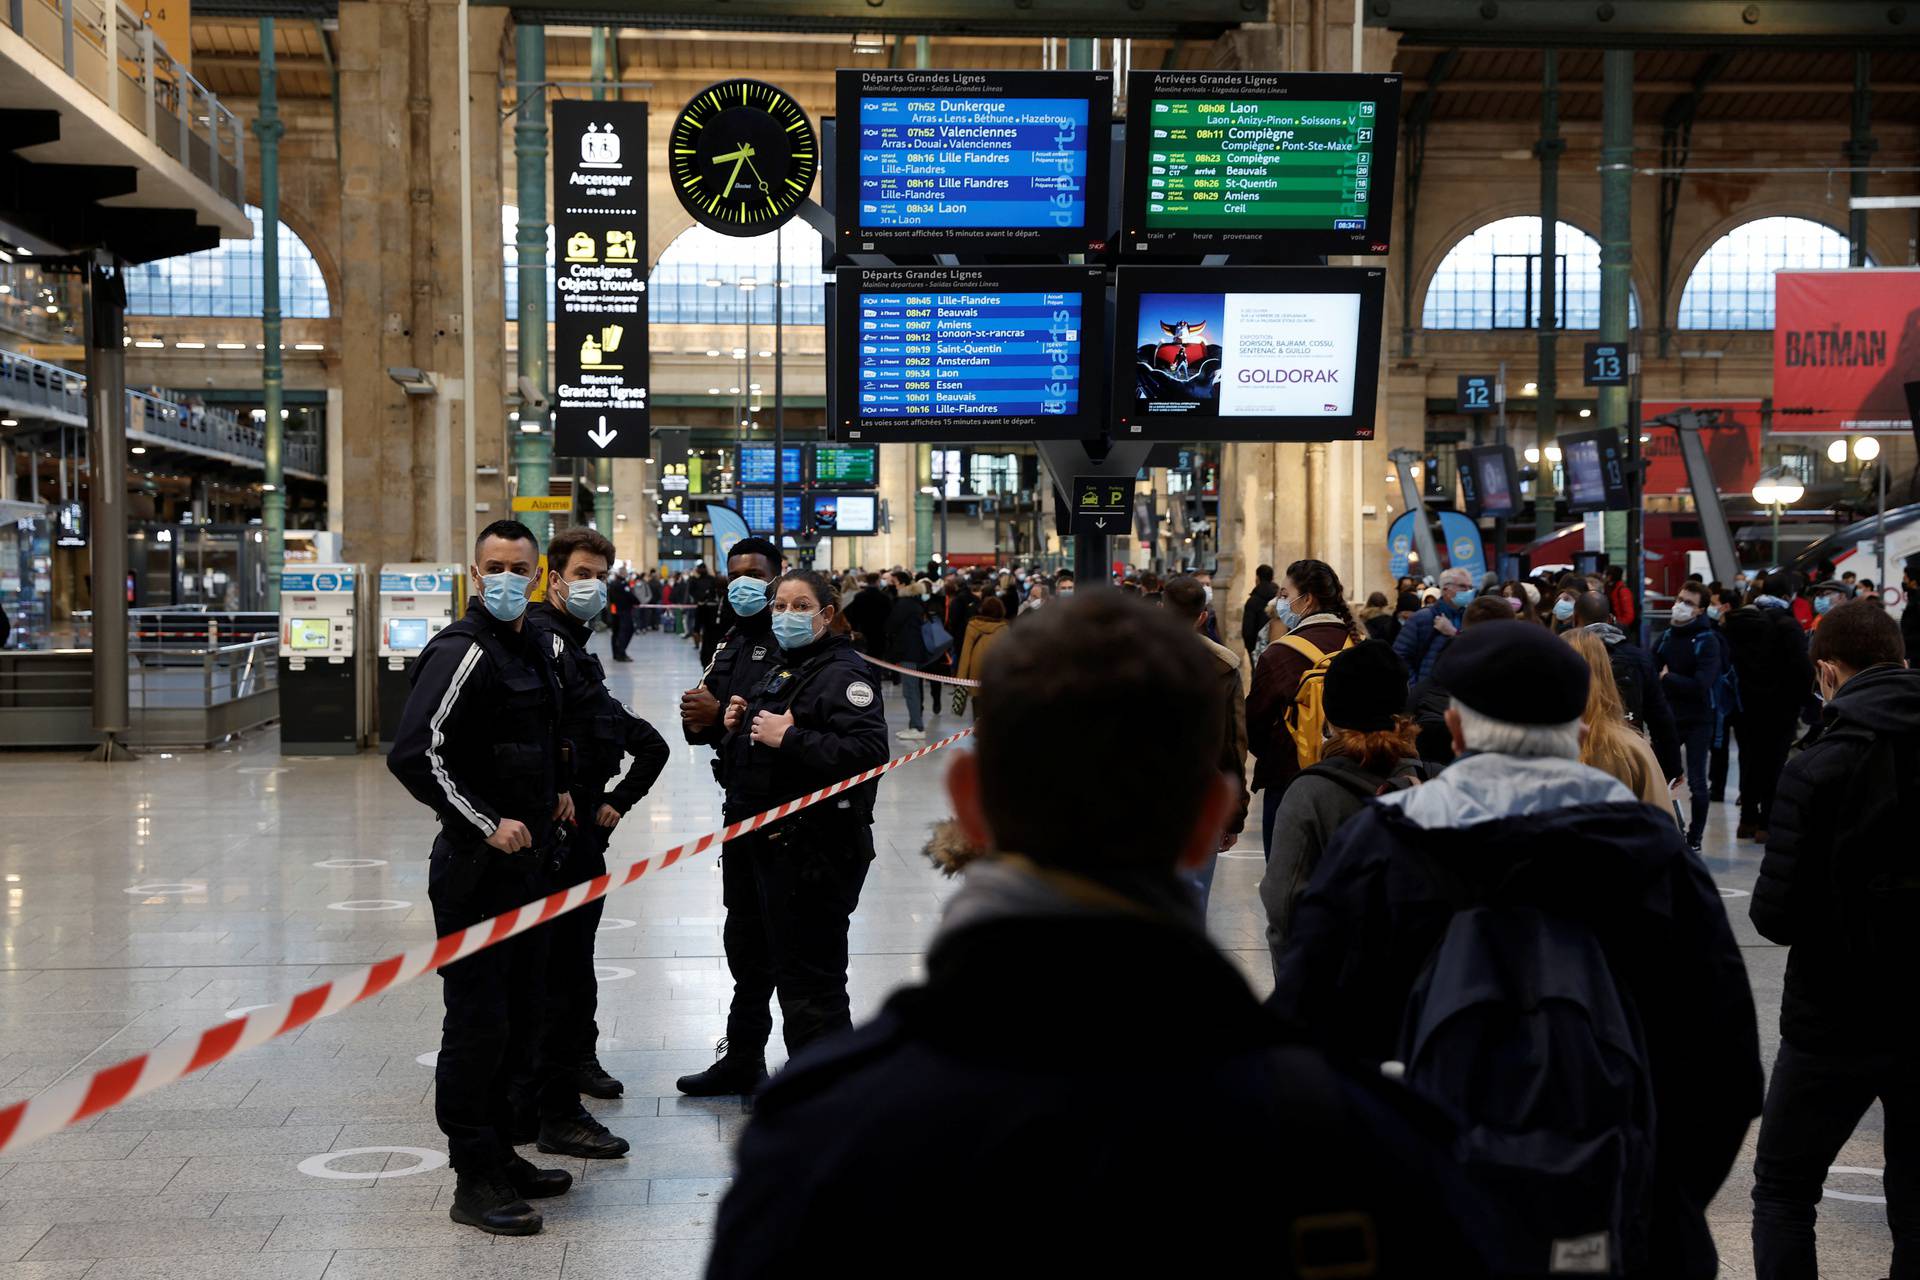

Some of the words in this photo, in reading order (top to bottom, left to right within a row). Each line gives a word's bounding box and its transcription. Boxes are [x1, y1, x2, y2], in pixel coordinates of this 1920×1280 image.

[862, 73, 904, 84] Départs
[907, 73, 950, 83] Grandes
[953, 74, 986, 85] Lignes
[1154, 75, 1197, 84] Arrivées
[1199, 75, 1242, 84] Grandes
[1244, 75, 1278, 86] Lignes
[907, 102, 935, 111] 07h52
[940, 100, 1005, 113] Dunkerque
[1198, 104, 1225, 113] 08h08
[1230, 102, 1258, 113] Laon
[1362, 105, 1373, 114] 19
[911, 114, 937, 123] Arras
[944, 114, 967, 123] Lens
[974, 113, 1014, 123] Béthune
[1021, 114, 1067, 123] Hazebrou
[1207, 115, 1230, 124] Laon
[1237, 115, 1293, 127] Anizy-Pinon
[1301, 116, 1341, 125] Soissons
[907, 128, 935, 137] 07h52
[940, 126, 1017, 137] Valenciennes
[1196, 130, 1224, 139] 08h11
[1228, 128, 1294, 141] Compiègne
[1359, 131, 1371, 139] 21
[881, 139, 907, 148] Arras
[914, 139, 942, 148] Douai
[949, 139, 1012, 149] Valenciennes
[1221, 141, 1275, 152] Compiègne
[1281, 141, 1353, 151] Pont-Ste-Maxe
[907, 153, 935, 162] 08h16
[939, 152, 962, 163] Lille
[964, 152, 1010, 163] Flandres
[1195, 154, 1221, 162] 08h23
[1226, 153, 1280, 165] Compiègne
[881, 164, 946, 174] Lille-Flandres
[1050, 117, 1080, 226] départs
[1226, 166, 1267, 176] Beauvais
[569, 172, 633, 186] Ascenseur
[906, 179, 934, 188] 08h16
[939, 178, 961, 188] Lille
[964, 178, 1009, 188] Flandres
[1194, 179, 1219, 188] 08h26
[1225, 178, 1278, 189] St-Quentin
[881, 190, 945, 199] Lille-Flandres
[1193, 192, 1219, 200] 08h29
[1224, 191, 1260, 200] Amiens
[906, 204, 934, 213] 08h34
[939, 202, 967, 213] Laon
[1224, 204, 1246, 213] Creil
[898, 215, 921, 224] Laon
[1014, 230, 1040, 238] départ.
[1193, 232, 1213, 240] heure
[570, 264, 633, 280] Consignes
[862, 271, 903, 281] Départs
[905, 270, 947, 279] Grandes
[950, 270, 983, 281] Lignes
[557, 277, 599, 293] Objets
[600, 278, 646, 292] trouvés
[937, 296, 1001, 305] Lille-Flandres
[906, 309, 931, 317] 08h47
[937, 308, 978, 317] Beauvais
[937, 320, 972, 329] Amiens
[905, 333, 931, 341] 09h12
[905, 346, 931, 354] 09h19
[937, 344, 1002, 354] Saint-Quentin
[1785, 330, 1886, 368] BATMAN
[905, 358, 930, 366] 09h22
[936, 356, 990, 365] Amsterdam
[1045, 310, 1074, 414] départs
[1593, 357, 1620, 377] 13
[905, 369, 930, 378] 09h34
[936, 368, 959, 378] Laon
[1238, 369, 1339, 383] GOLDORAK
[580, 375, 624, 385] Billetterie
[936, 380, 963, 389] Essen
[558, 384, 609, 398] Grandes
[610, 385, 647, 400] lignes
[936, 392, 976, 401] Beauvais
[1465, 387, 1489, 404] 12
[936, 404, 998, 413] Lille-Flandres
[1011, 418, 1036, 426] départ.
[1110, 492, 1122, 505] P
[531, 501, 570, 509] Alarme
